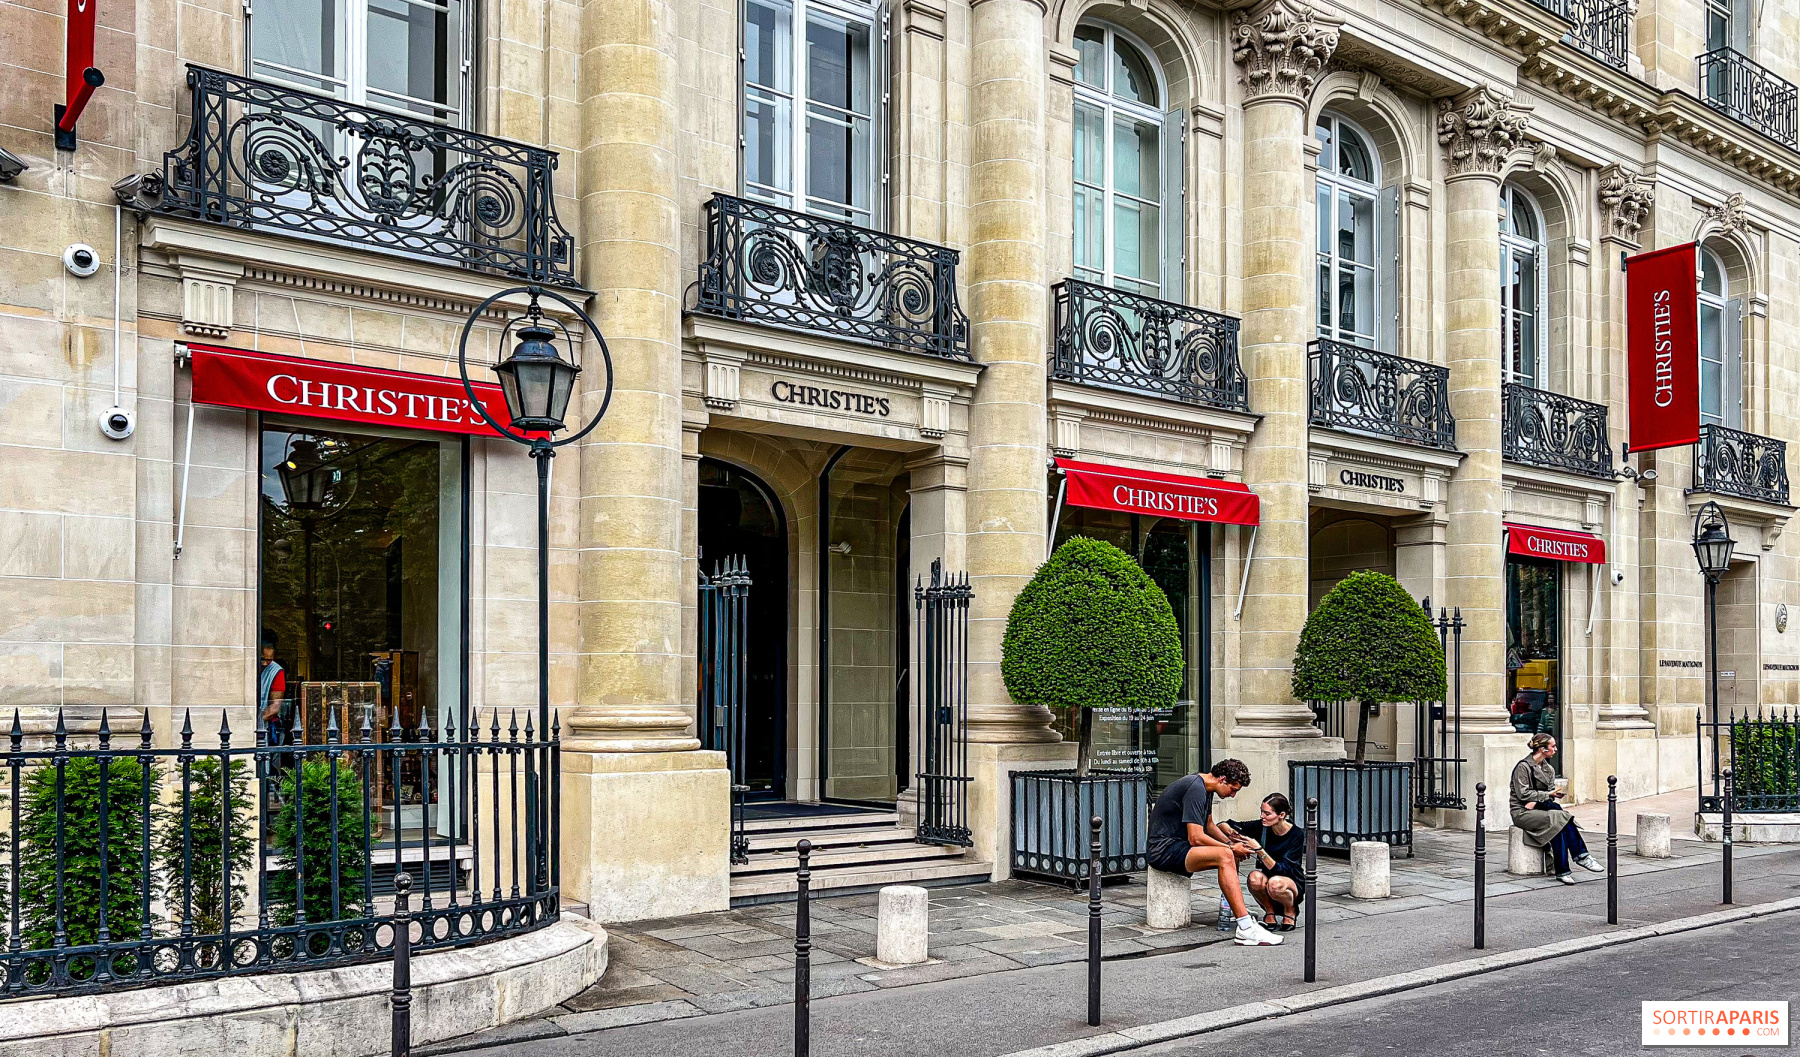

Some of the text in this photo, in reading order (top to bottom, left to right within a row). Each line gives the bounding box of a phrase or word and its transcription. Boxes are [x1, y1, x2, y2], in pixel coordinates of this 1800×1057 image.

[1653, 289, 1673, 408] CHRISTIE'S
[266, 374, 489, 426] CHRISTIE'S
[771, 380, 890, 417] CHRISTIE'S
[1340, 469, 1405, 493] CHRISTIE'S
[1113, 484, 1219, 516] CHRISTIE'S
[1527, 535, 1588, 558] CHRISTIE'S
